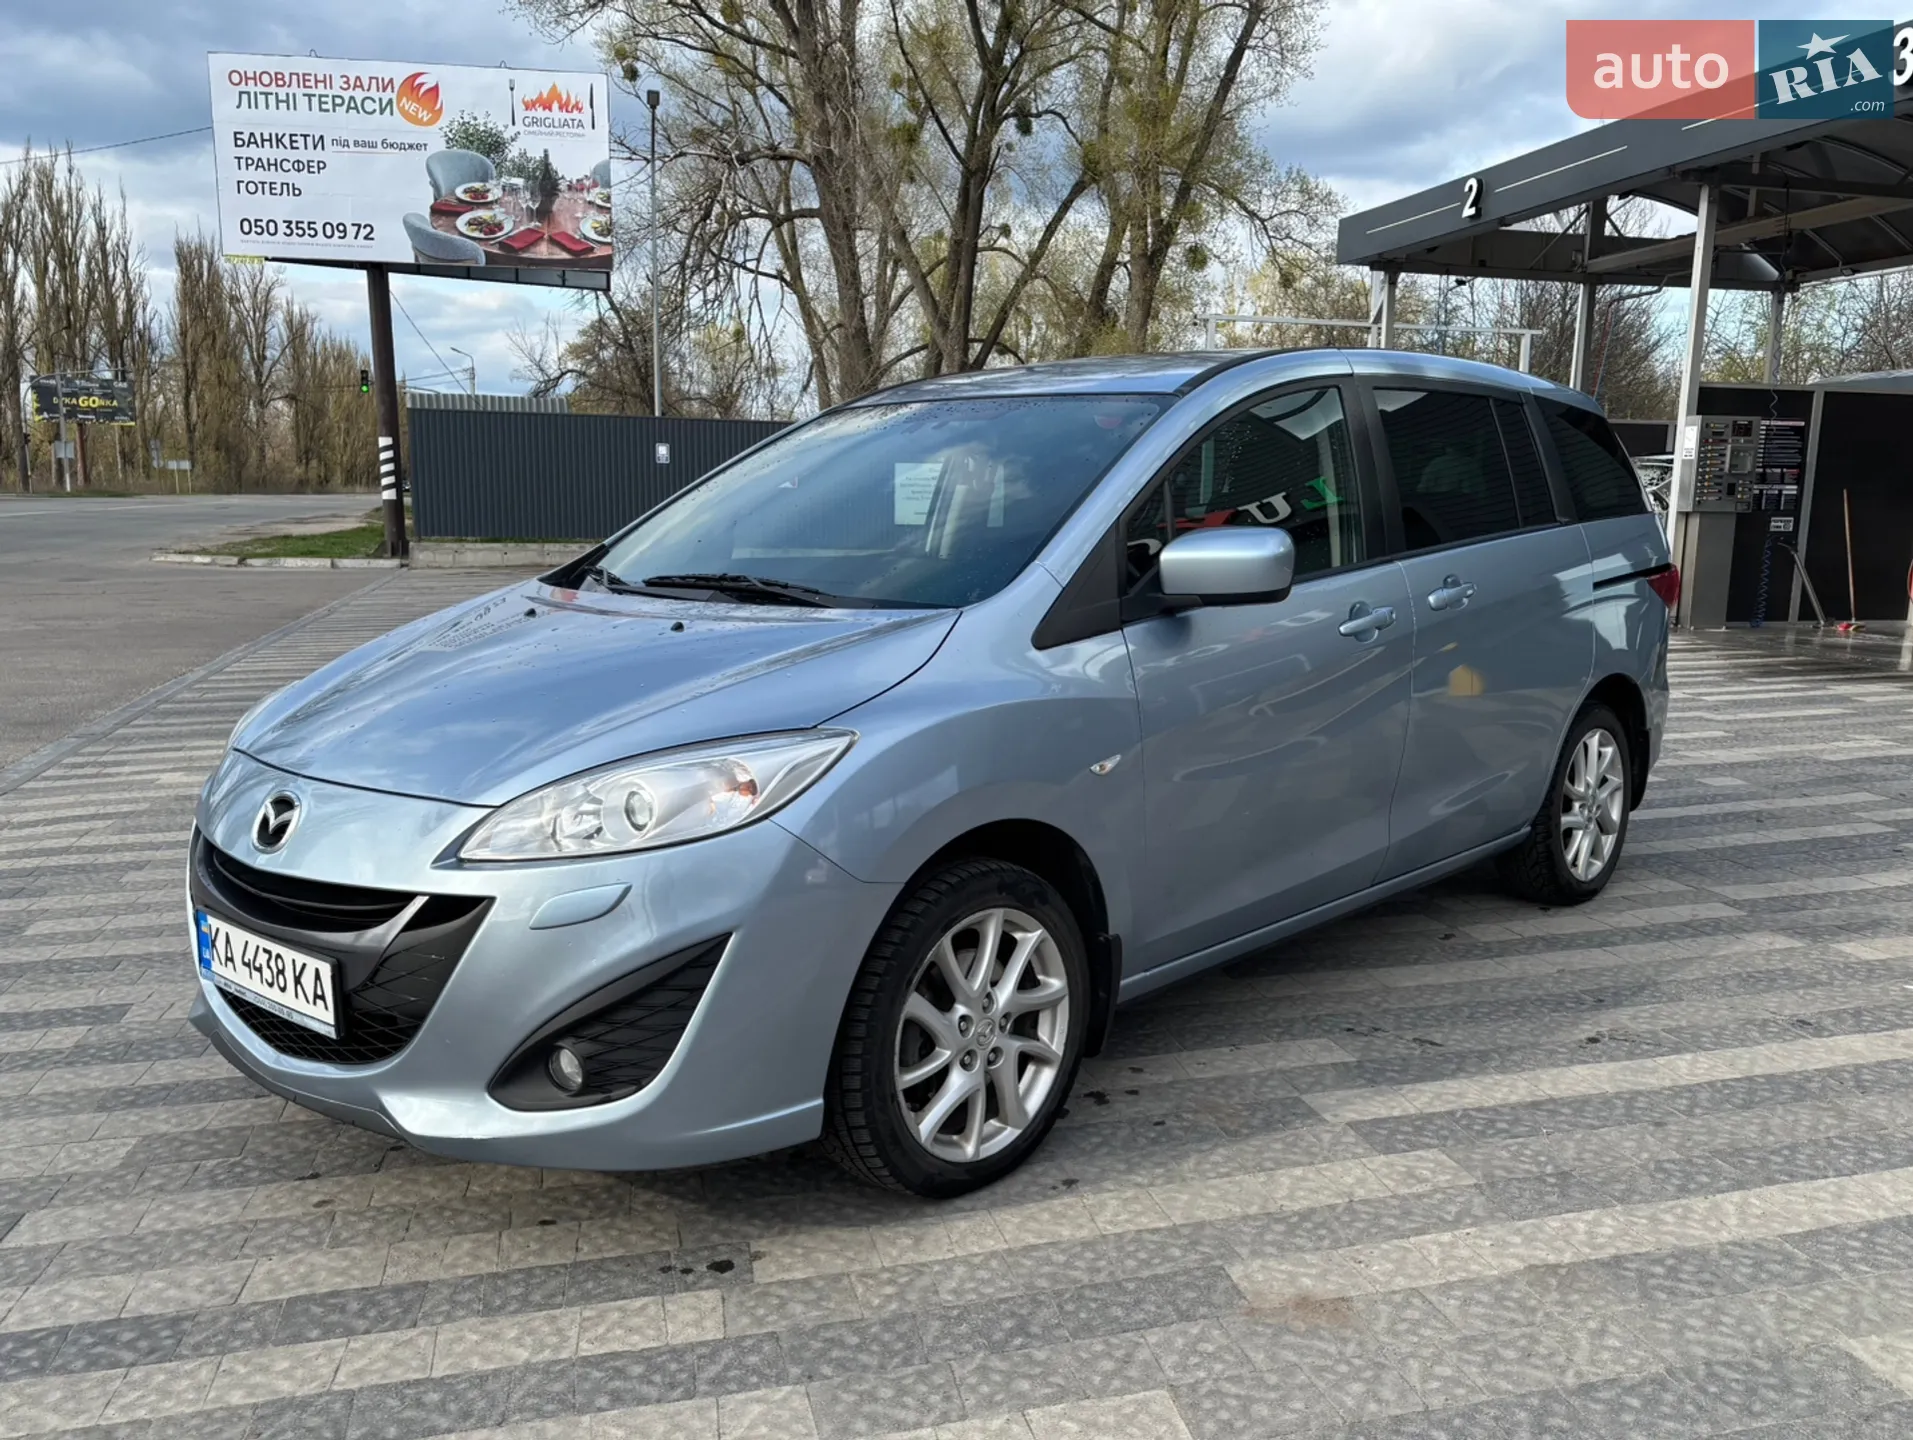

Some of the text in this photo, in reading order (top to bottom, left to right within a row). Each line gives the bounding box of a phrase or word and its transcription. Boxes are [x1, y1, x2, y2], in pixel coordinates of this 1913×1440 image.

[228, 69, 395, 93] ОНОВЛЕНІ ЗАЛИ
[236, 91, 394, 116] ЛІТНІ ТЕРАСИ
[399, 96, 433, 123] NEW
[522, 115, 585, 129] GRIGLIATA
[233, 131, 428, 152] БАНКЕТИ під ваш бюджет
[233, 156, 327, 174] ТРАНСФЕР
[236, 180, 302, 197] ГОТЕЛЬ
[1461, 177, 1479, 219] 2
[239, 217, 375, 241] 050 355 09 72
[208, 923, 237, 973] KA
[241, 940, 287, 994] 4438
[292, 958, 329, 1011] KA
